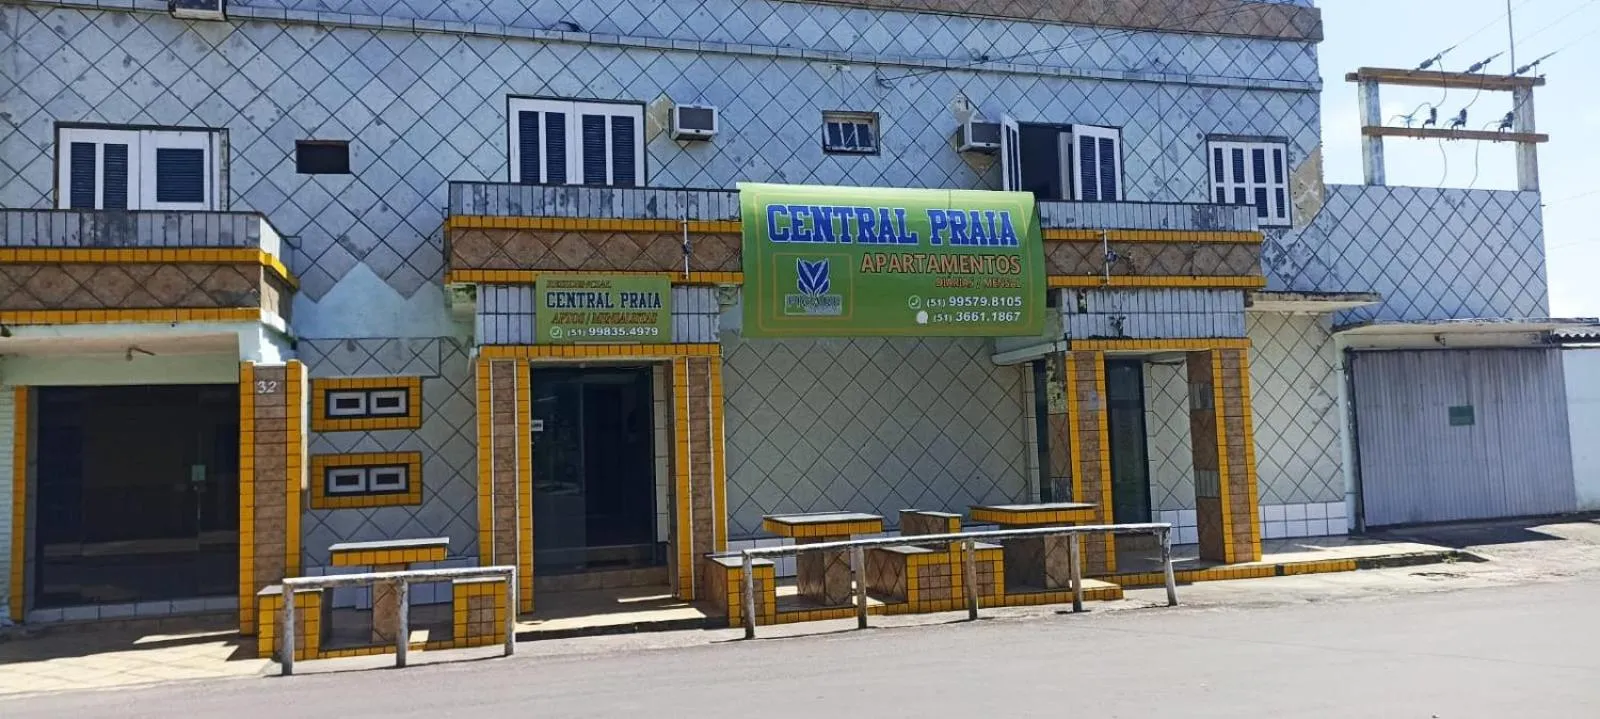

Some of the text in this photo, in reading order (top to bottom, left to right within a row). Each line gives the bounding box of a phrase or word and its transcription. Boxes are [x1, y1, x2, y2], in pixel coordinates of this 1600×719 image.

[766, 203, 1019, 247] CENTRAL PRAIA
[860, 252, 1021, 275] APARTAMENTOS
[546, 291, 662, 309] CENTRAL PRAIA
[927, 295, 1022, 308] (51) 99579.8105
[933, 311, 1021, 323] (51) 3661.1867
[567, 326, 658, 337] (51) 99835.4979
[257, 380, 277, 394] 32
